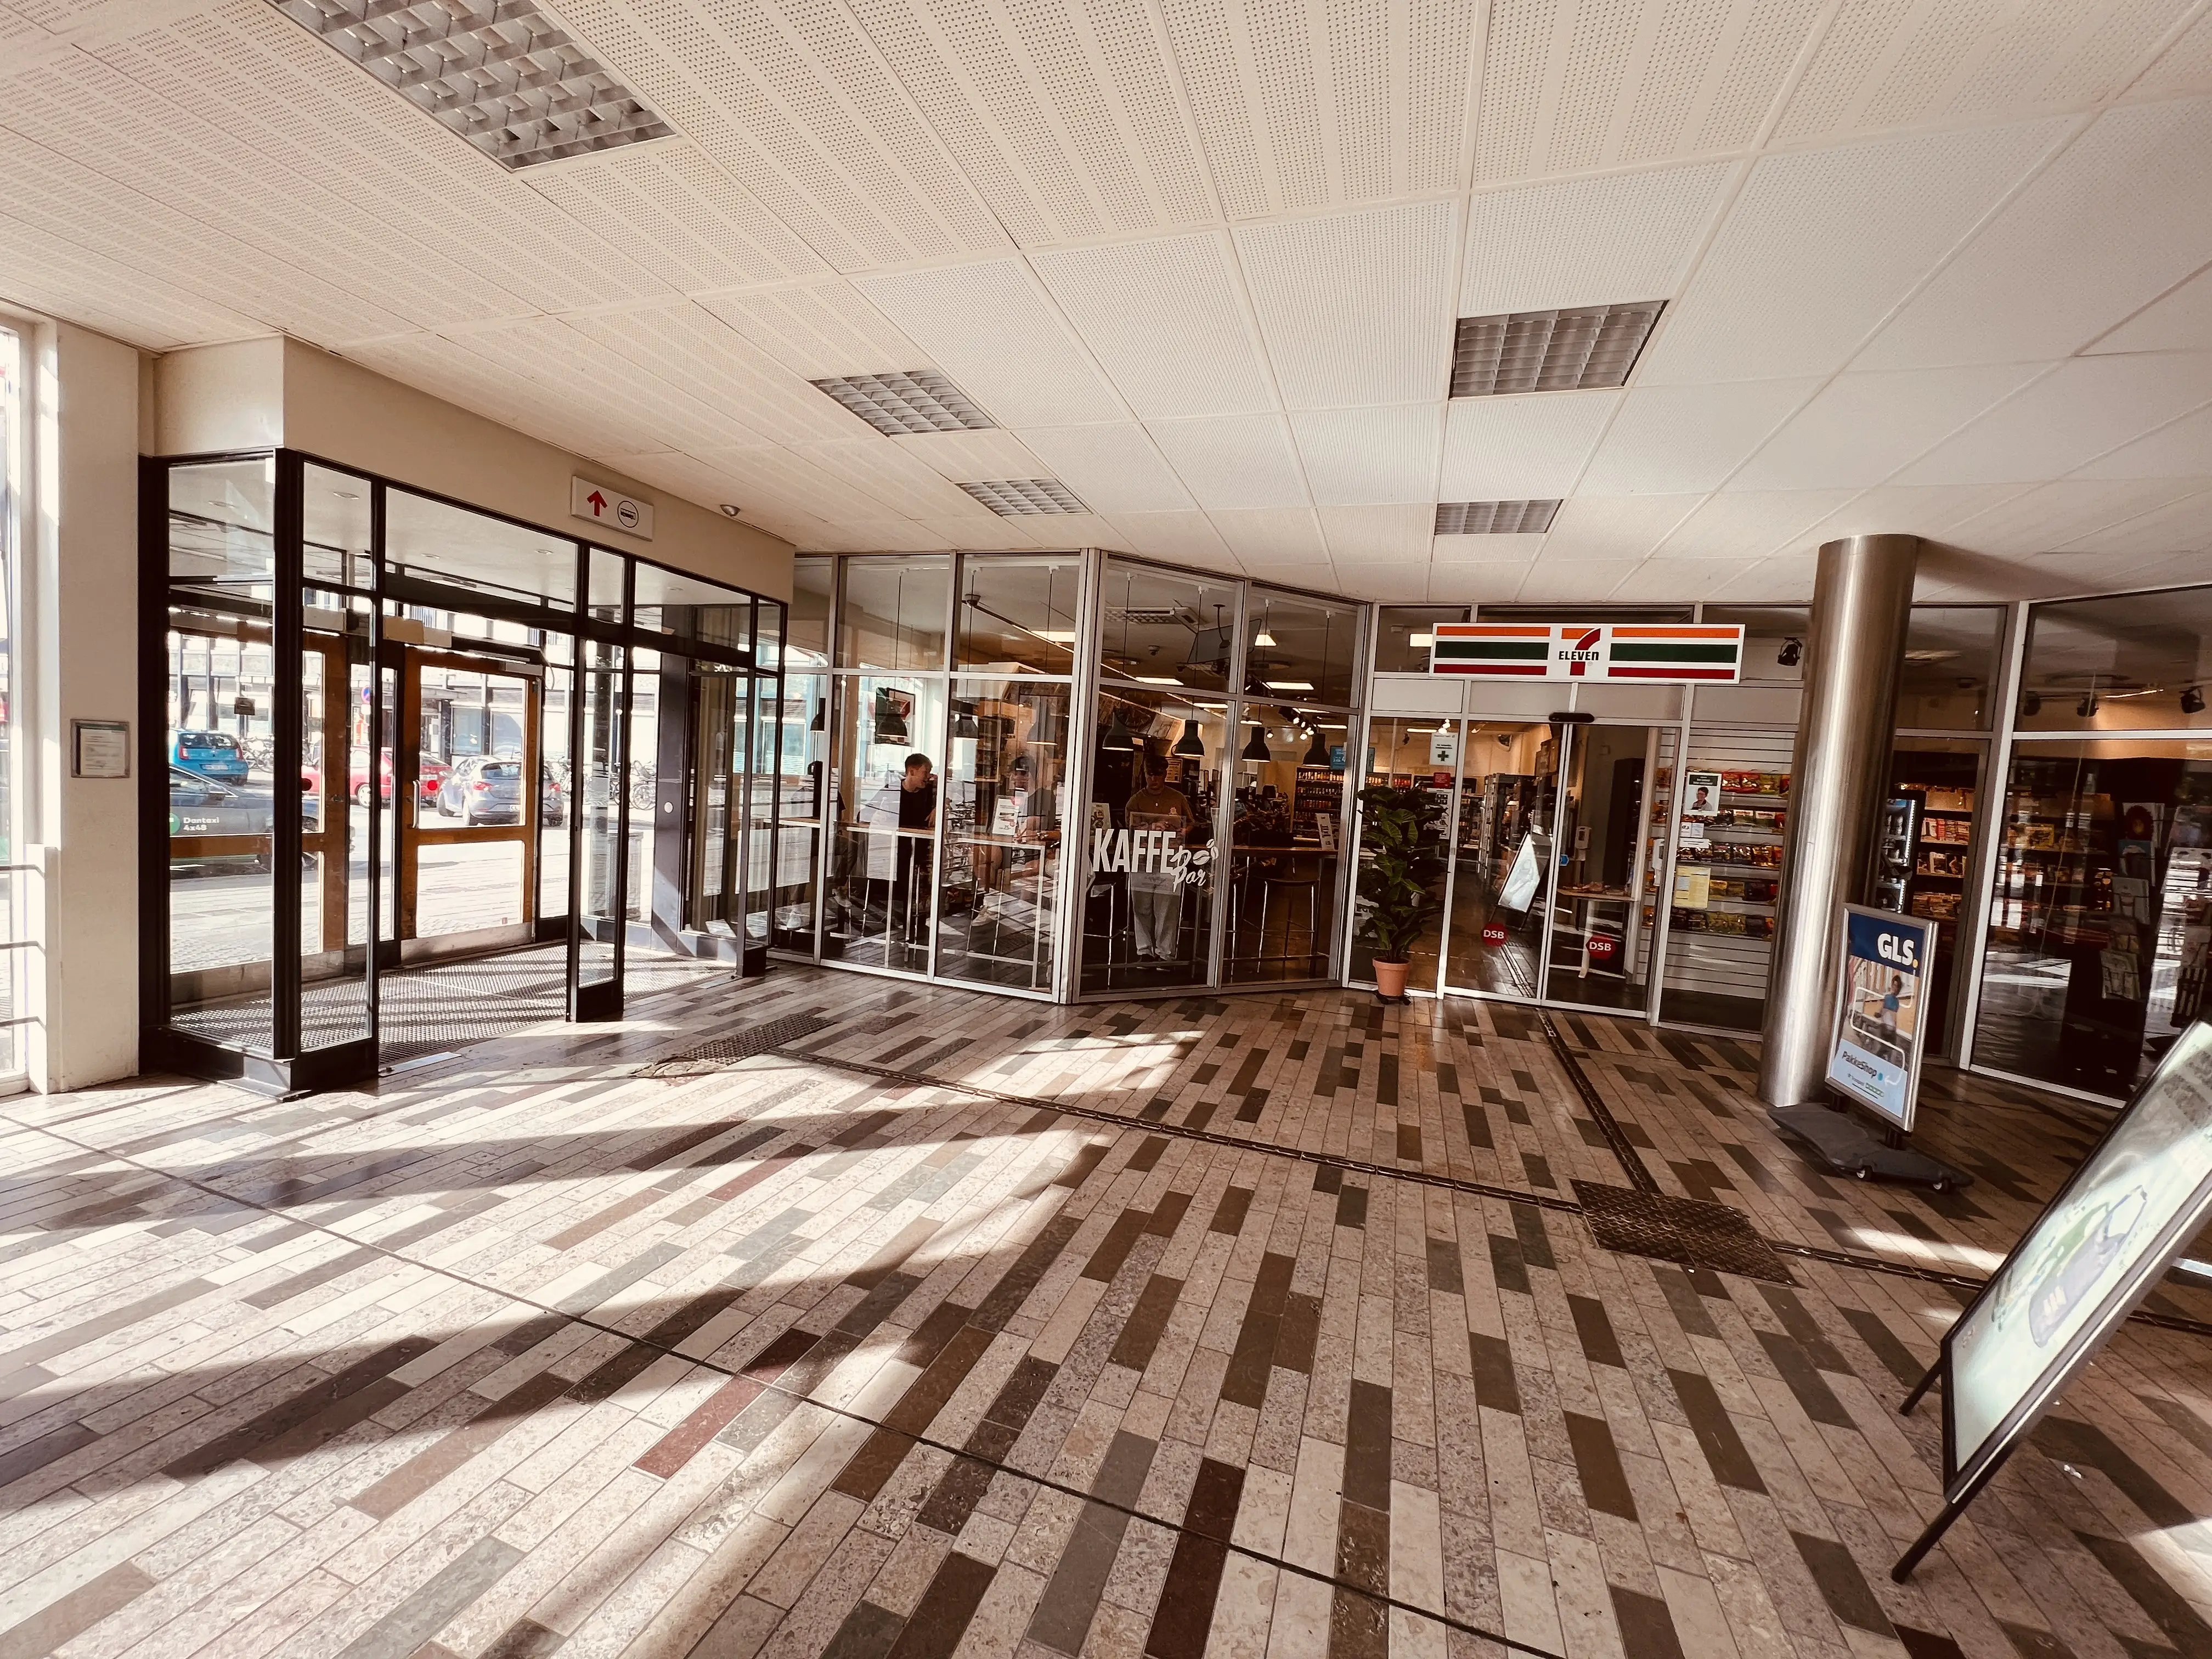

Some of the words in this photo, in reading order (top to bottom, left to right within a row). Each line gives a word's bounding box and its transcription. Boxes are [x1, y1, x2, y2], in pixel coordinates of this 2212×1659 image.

[1561, 628, 1601, 676] 7
[1093, 828, 1176, 876] KAFFE
[1170, 845, 1206, 893] Bar
[1483, 929, 1504, 939] DSB
[1589, 941, 1611, 951] DSB
[1842, 1051, 1877, 1079] PakkeShop
